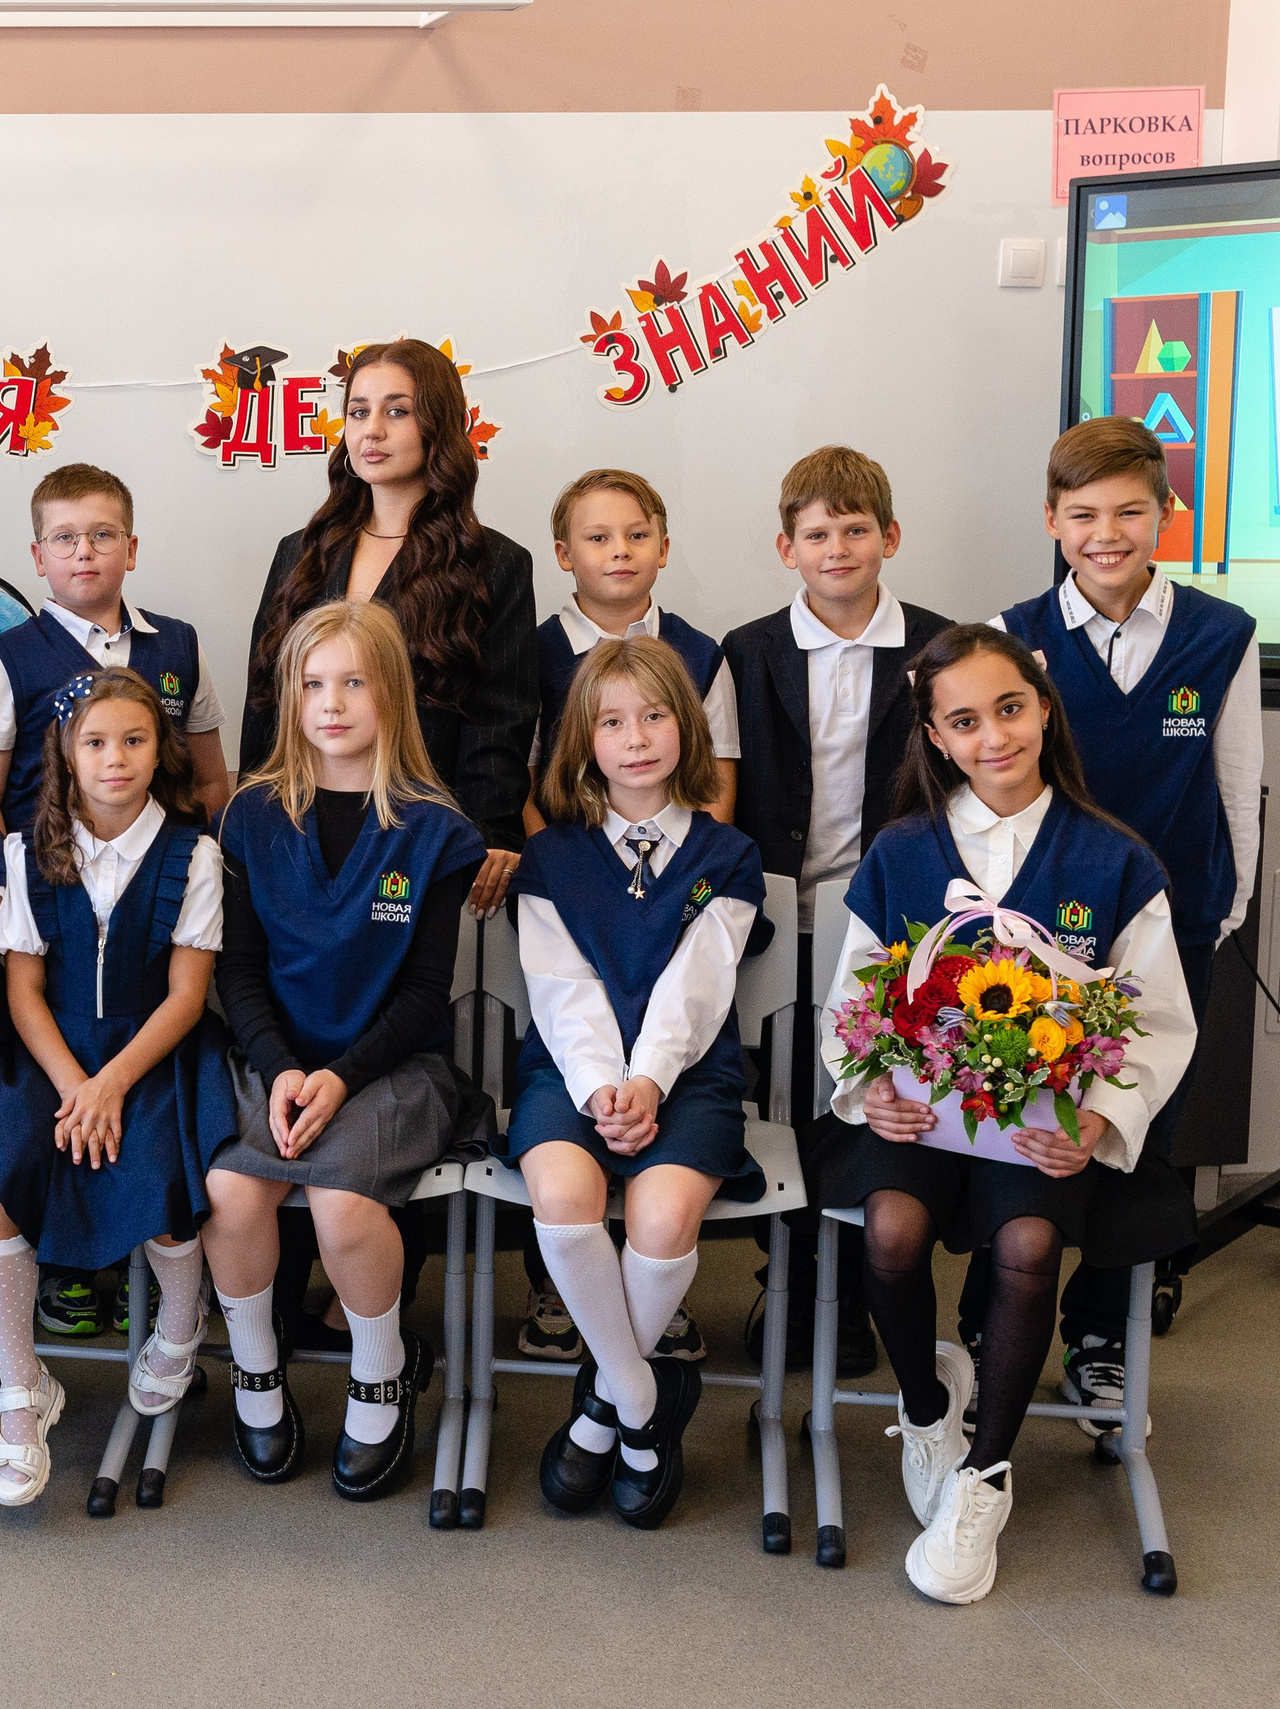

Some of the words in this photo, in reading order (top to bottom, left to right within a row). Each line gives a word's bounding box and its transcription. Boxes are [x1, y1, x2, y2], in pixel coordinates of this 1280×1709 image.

[1063, 115, 1194, 136] ПАРКОВКА
[1079, 151, 1176, 171] вопросов
[592, 154, 902, 406] ЗНАНИЙ
[1162, 717, 1206, 728] НОВАЯ
[1162, 727, 1207, 737] ШКОЛА
[372, 902, 412, 914] НОВАЯ
[371, 911, 410, 923] ШКОЛА
